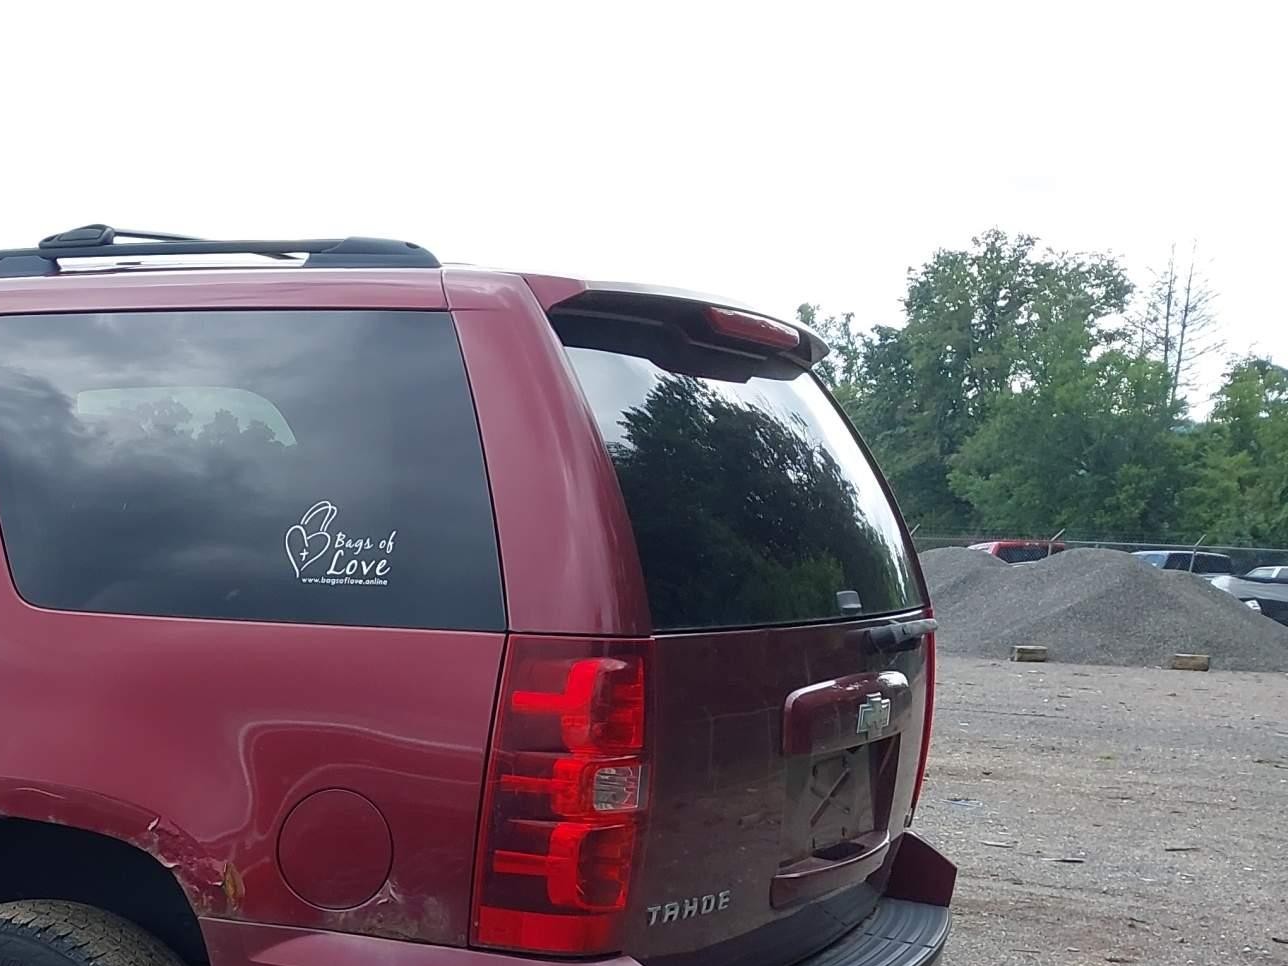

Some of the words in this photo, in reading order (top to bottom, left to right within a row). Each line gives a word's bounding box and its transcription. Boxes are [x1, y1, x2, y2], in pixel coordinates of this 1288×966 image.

[334, 532, 373, 555] Bags
[379, 531, 396, 554] of
[326, 549, 391, 576] Love
[647, 890, 731, 927] TAHOE
